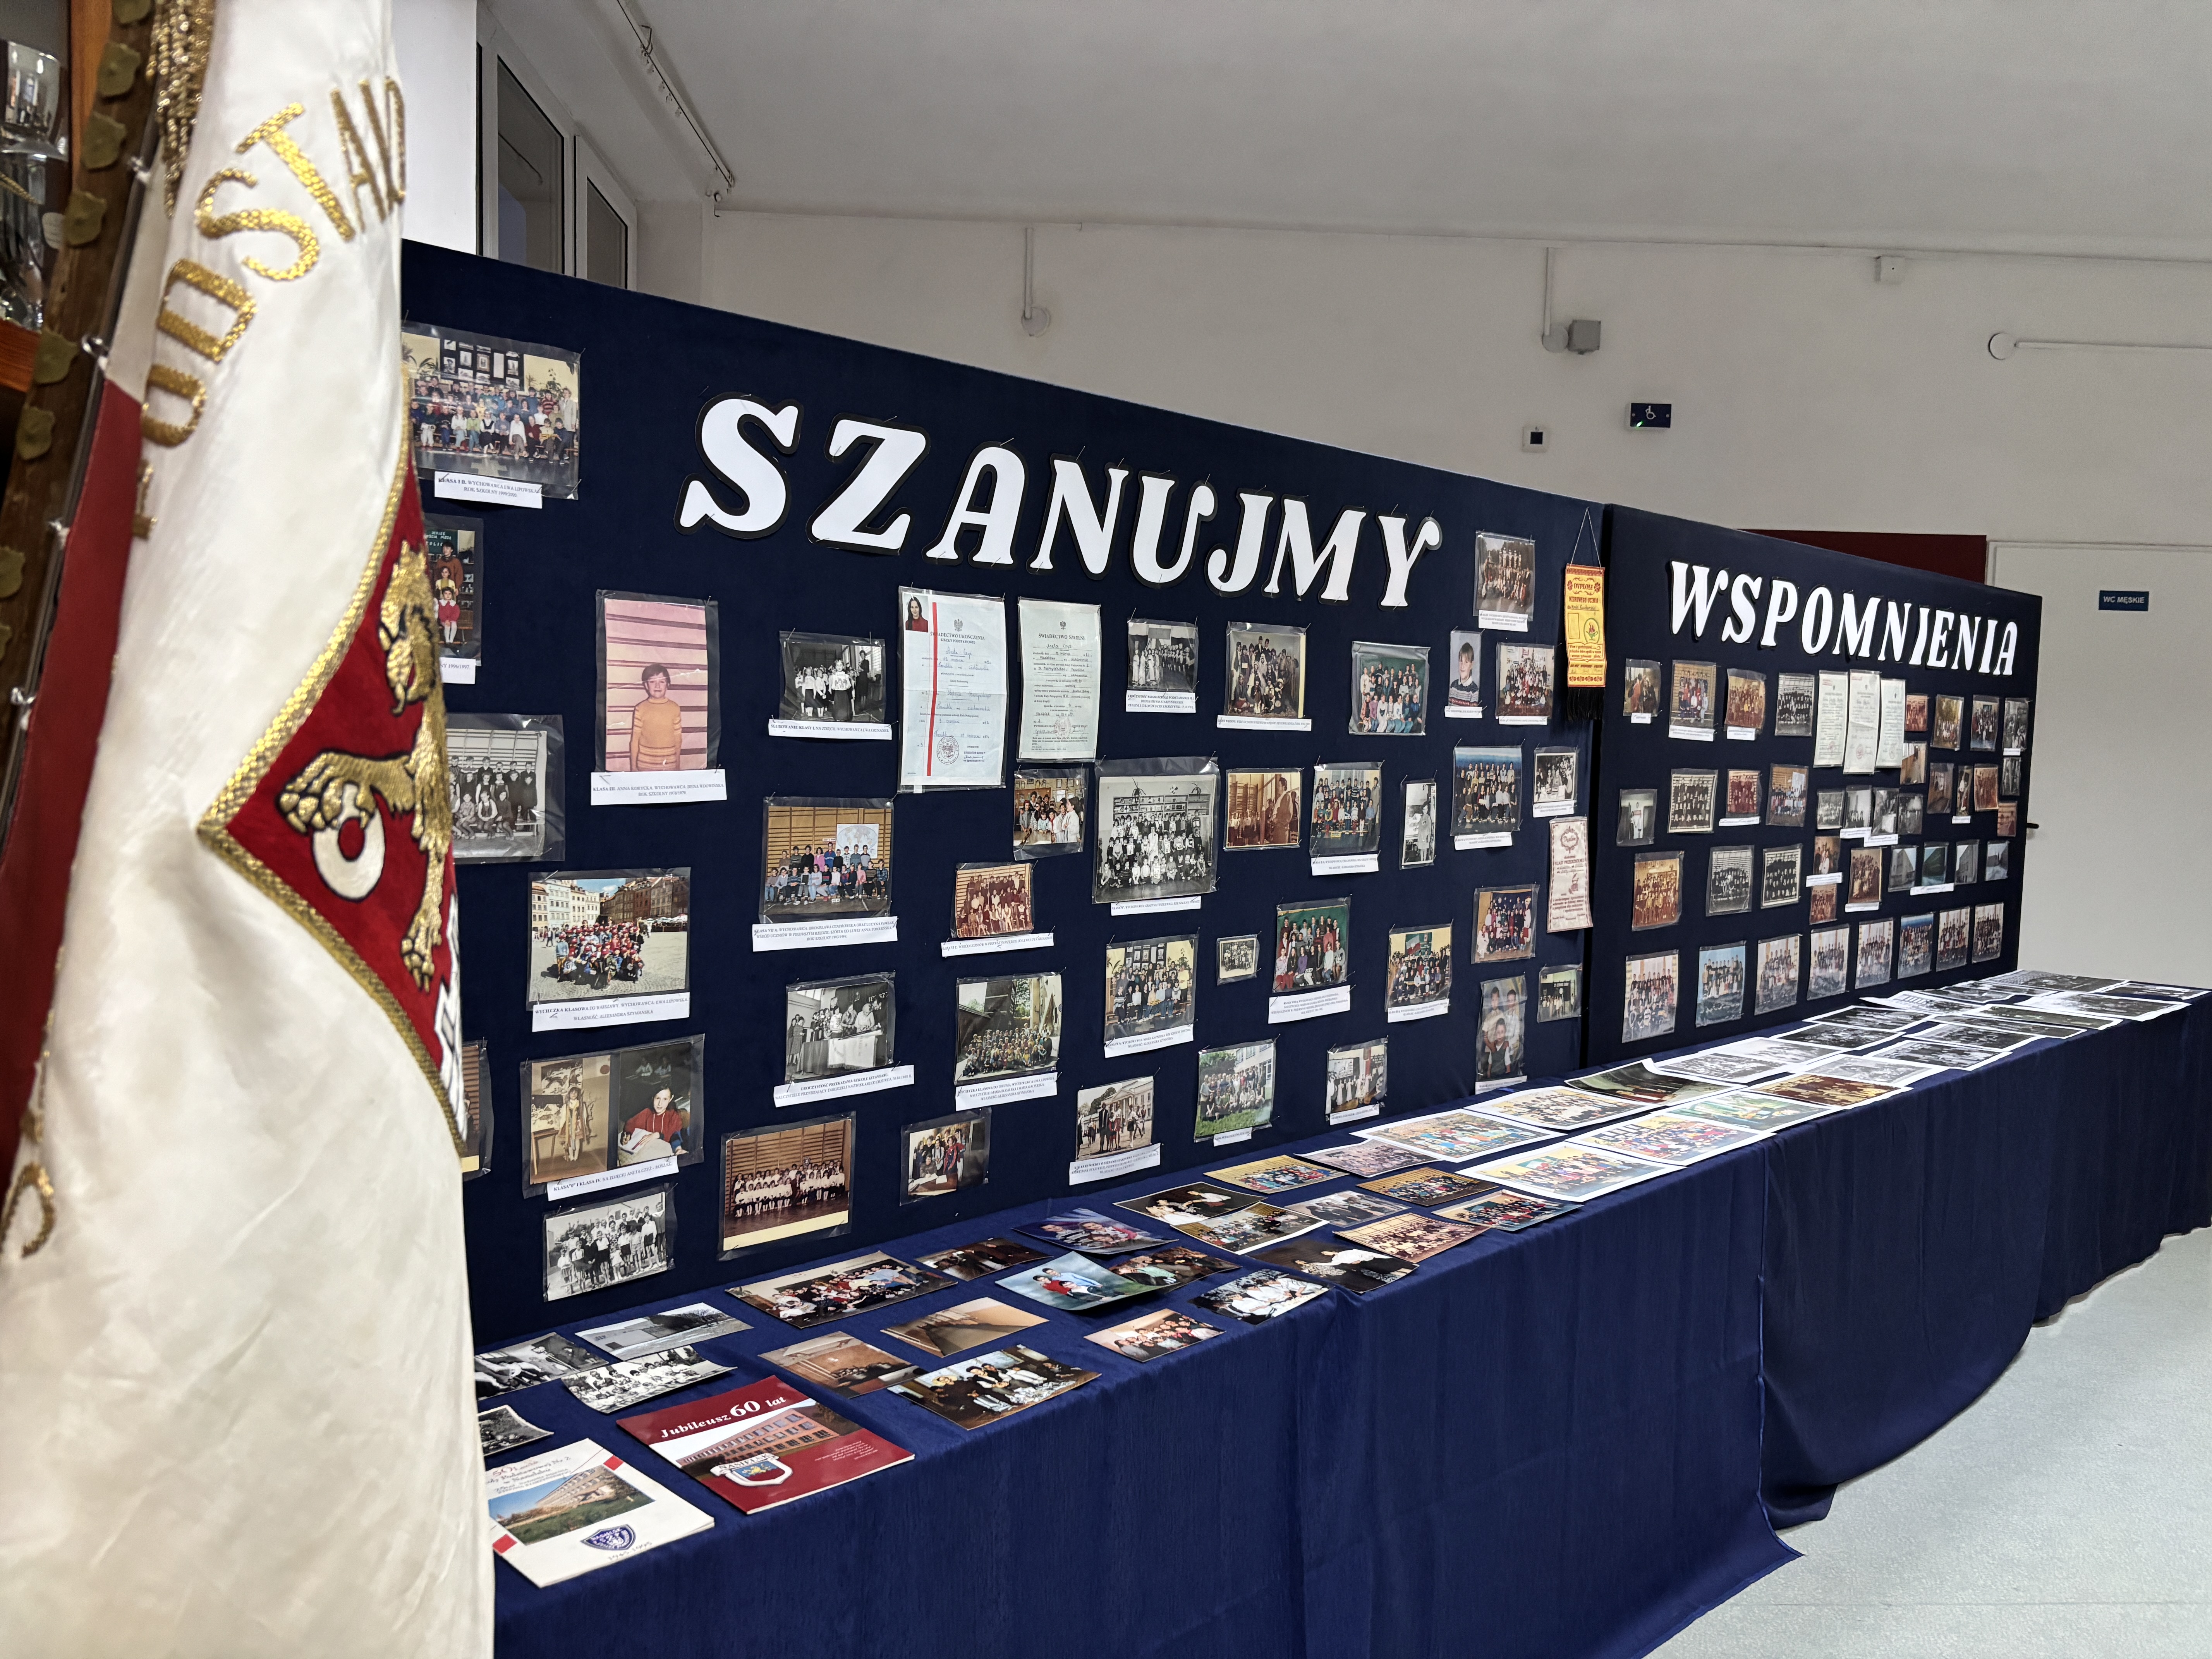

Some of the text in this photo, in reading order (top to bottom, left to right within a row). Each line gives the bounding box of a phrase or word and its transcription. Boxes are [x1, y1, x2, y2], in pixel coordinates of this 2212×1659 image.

[468, 481, 503, 489] WYCHOWAWCA
[680, 399, 1439, 606] SZANUJMY
[1672, 561, 2017, 675] WSPOMNIENIA
[662, 1396, 787, 1438] Jubileusz 60 lat
[718, 1454, 770, 1470] NASIELSK
